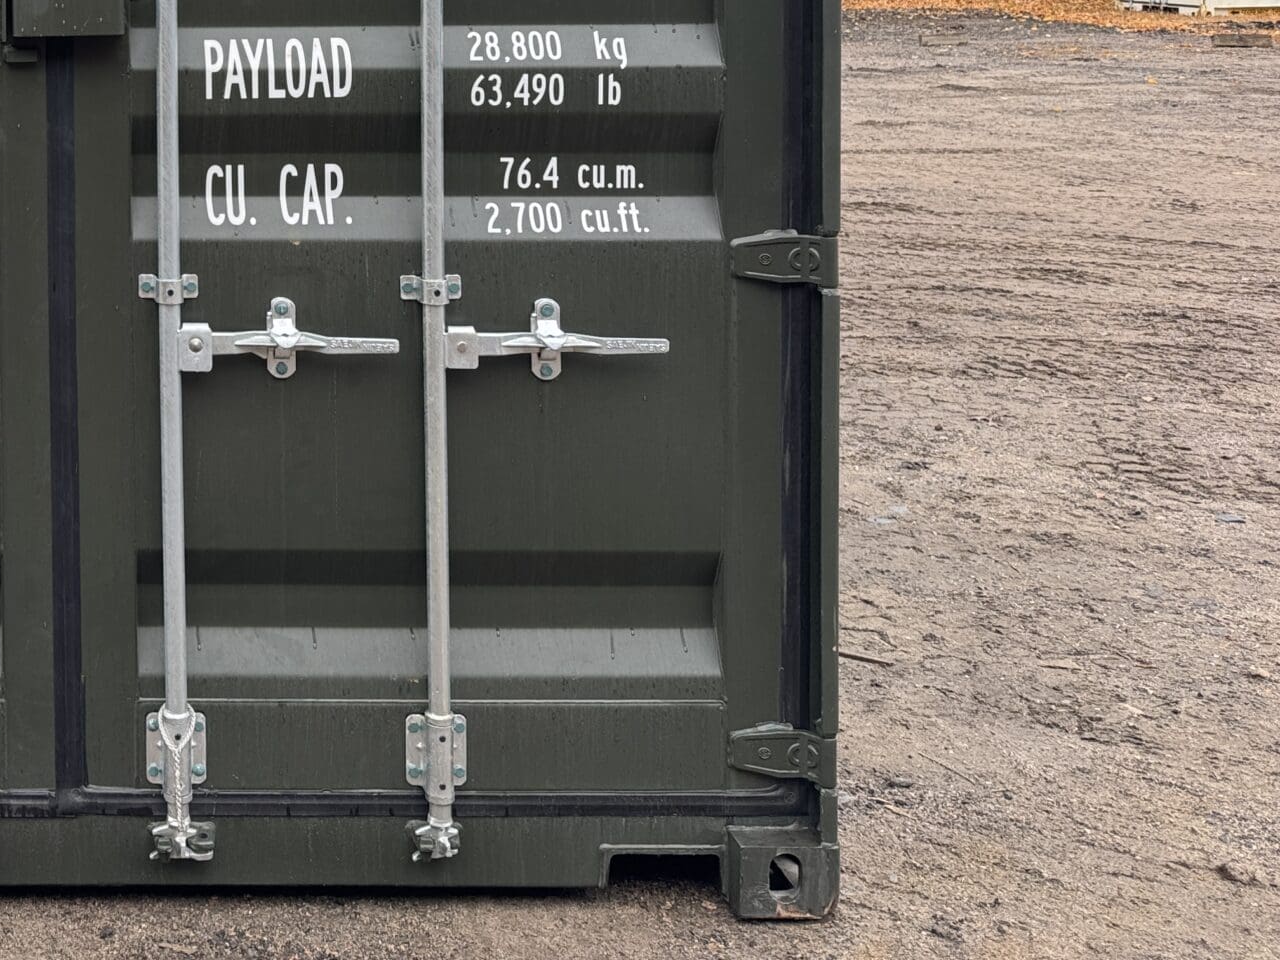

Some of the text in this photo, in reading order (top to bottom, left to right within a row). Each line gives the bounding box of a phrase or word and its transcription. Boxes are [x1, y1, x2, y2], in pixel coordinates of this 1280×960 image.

[203, 30, 628, 100] PAYLOAD 28,800 kg
[470, 73, 622, 109] 63,490 lb
[205, 156, 645, 227] CU. CAP. 76.4 cu.m.
[484, 201, 651, 236] 2,700 cu.ft.
